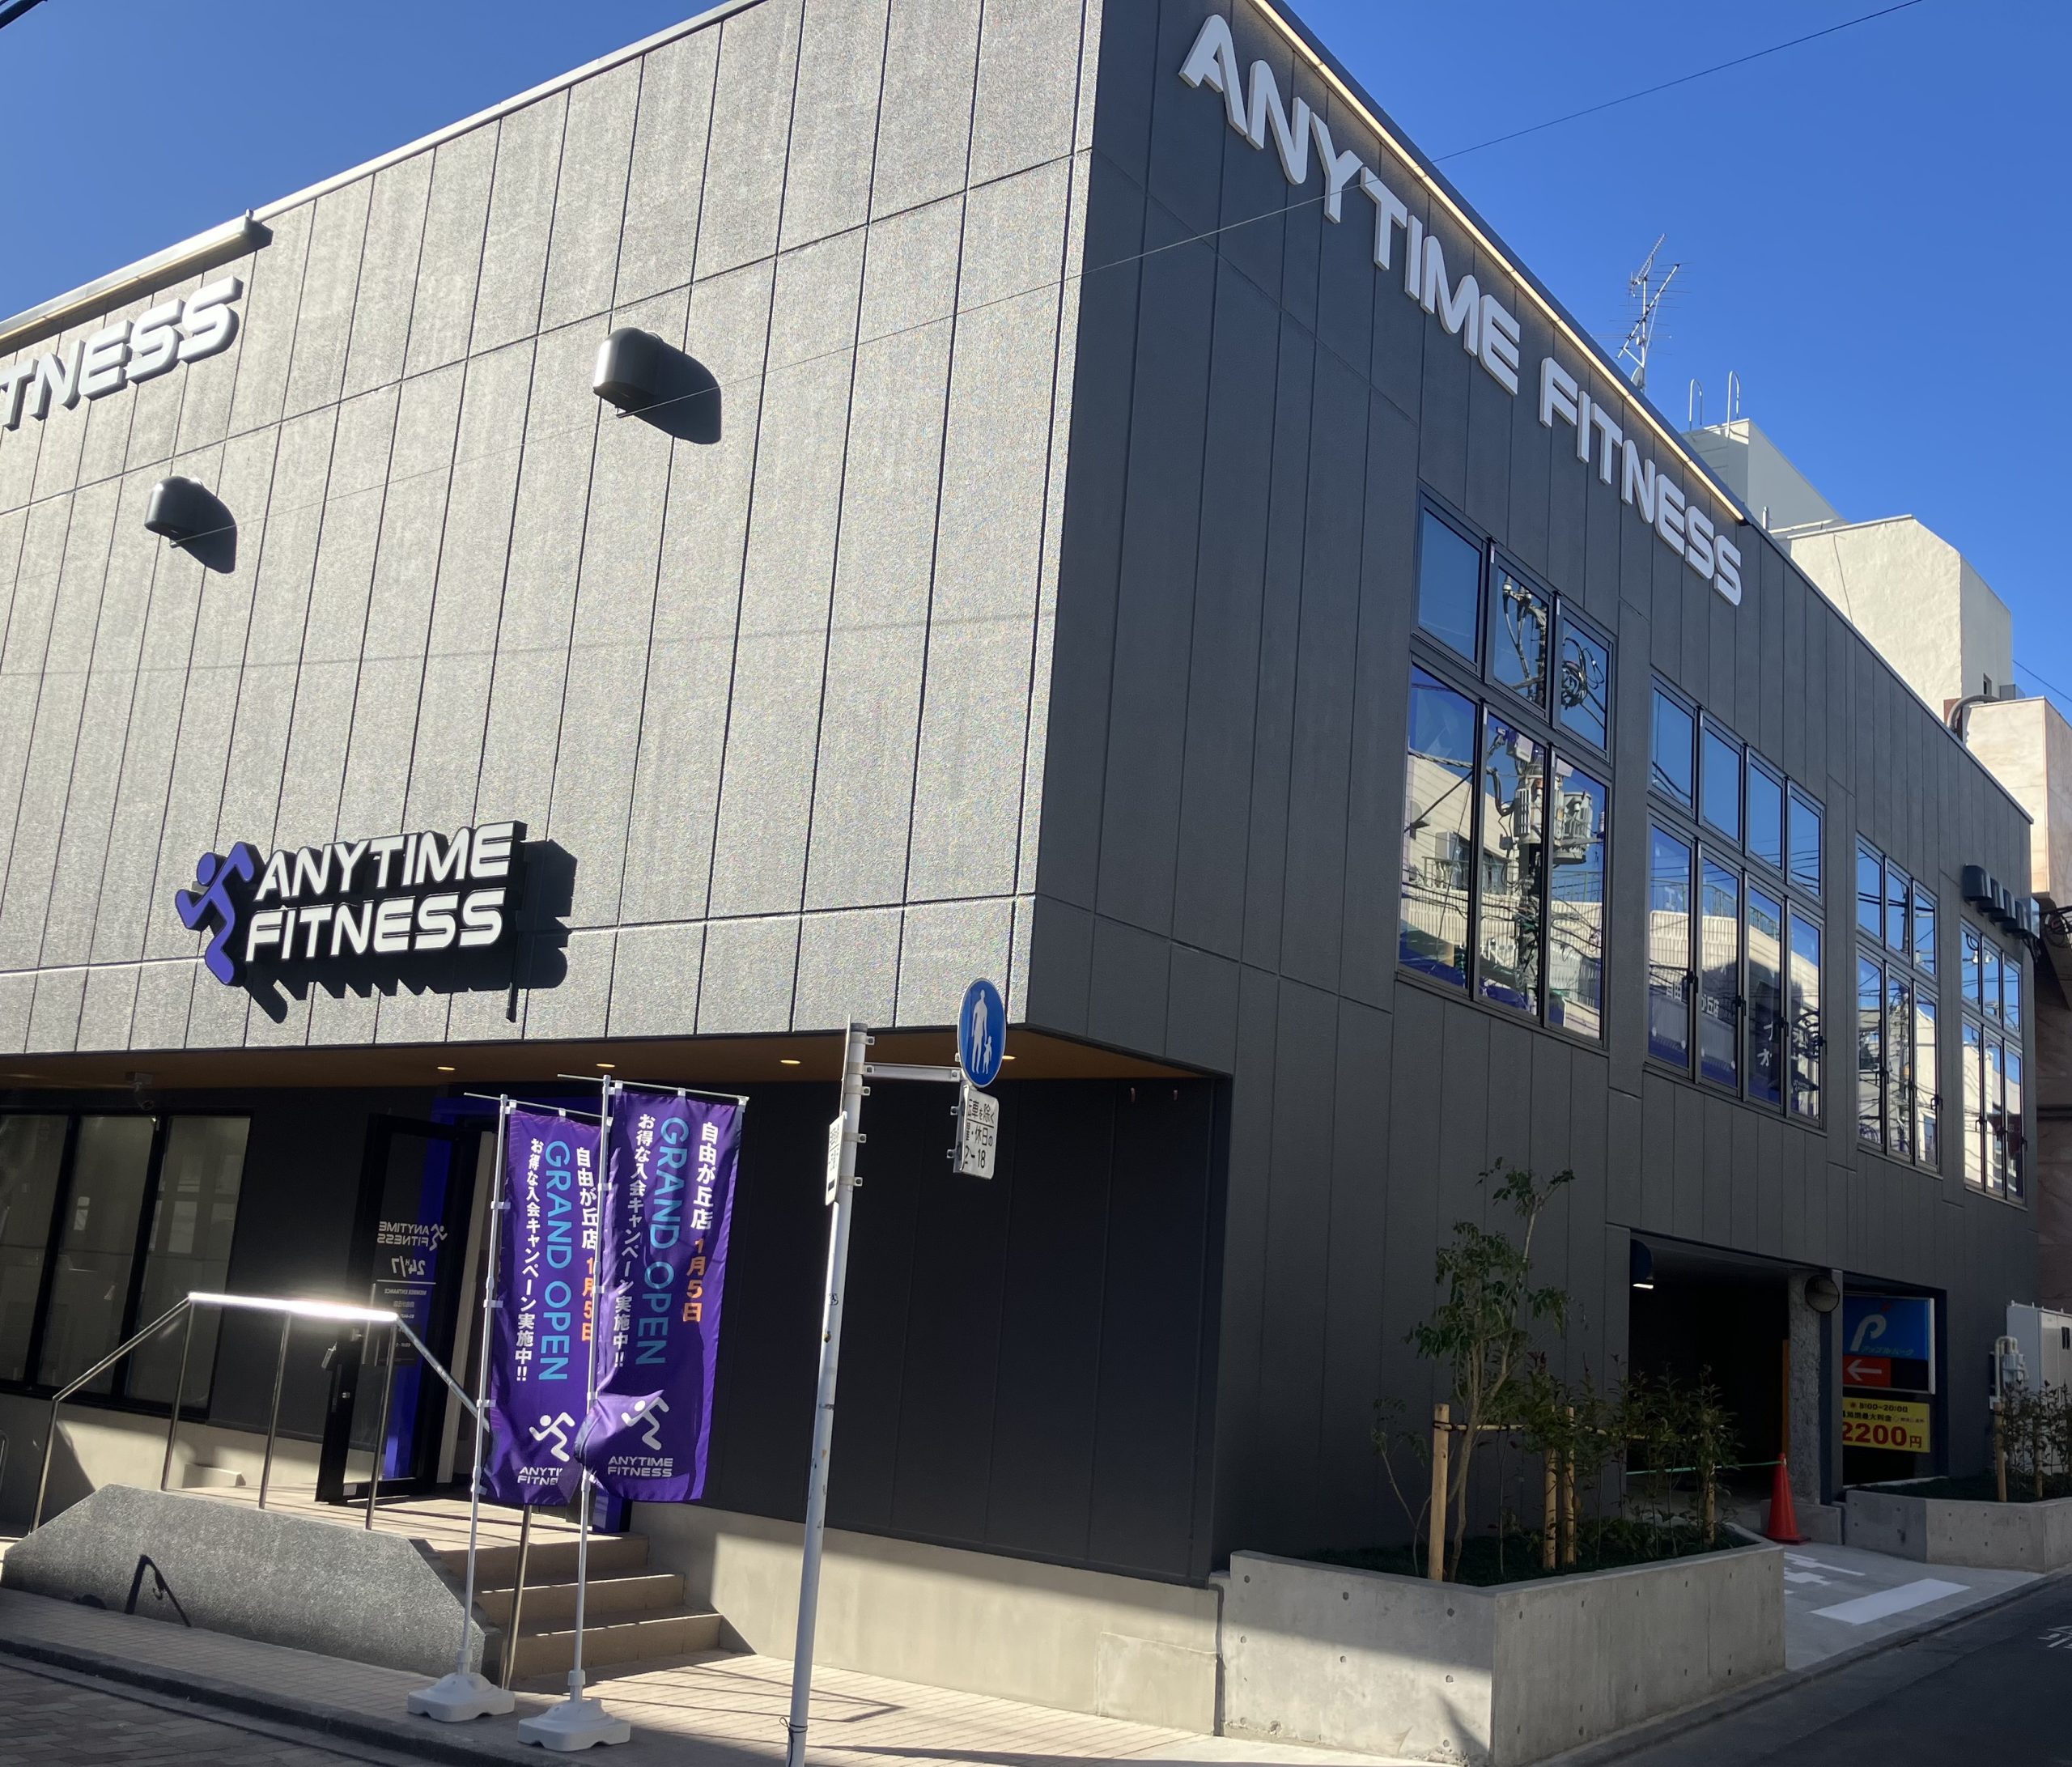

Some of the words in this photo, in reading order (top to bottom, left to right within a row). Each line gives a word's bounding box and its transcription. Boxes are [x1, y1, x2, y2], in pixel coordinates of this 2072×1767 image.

[1179, 14, 1519, 395] ANYTIME
[1540, 357, 1741, 606] FITNESS
[254, 822, 514, 901] ANYTIME
[246, 887, 506, 962] FITNESS
[545, 1140, 573, 1271] GRAND
[575, 1147, 598, 1250] 自由が丘店
[650, 1116, 690, 1247] GRAND
[690, 1121, 720, 1230] 自由が丘店
[635, 1259, 674, 1366] OPEN
[681, 1238, 706, 1323] 1月5日
[538, 1281, 572, 1381] OPEN
[519, 1466, 563, 1475] ANYTI
[607, 1466, 672, 1477] FITNESS
[608, 1455, 673, 1467] ANYTIME
